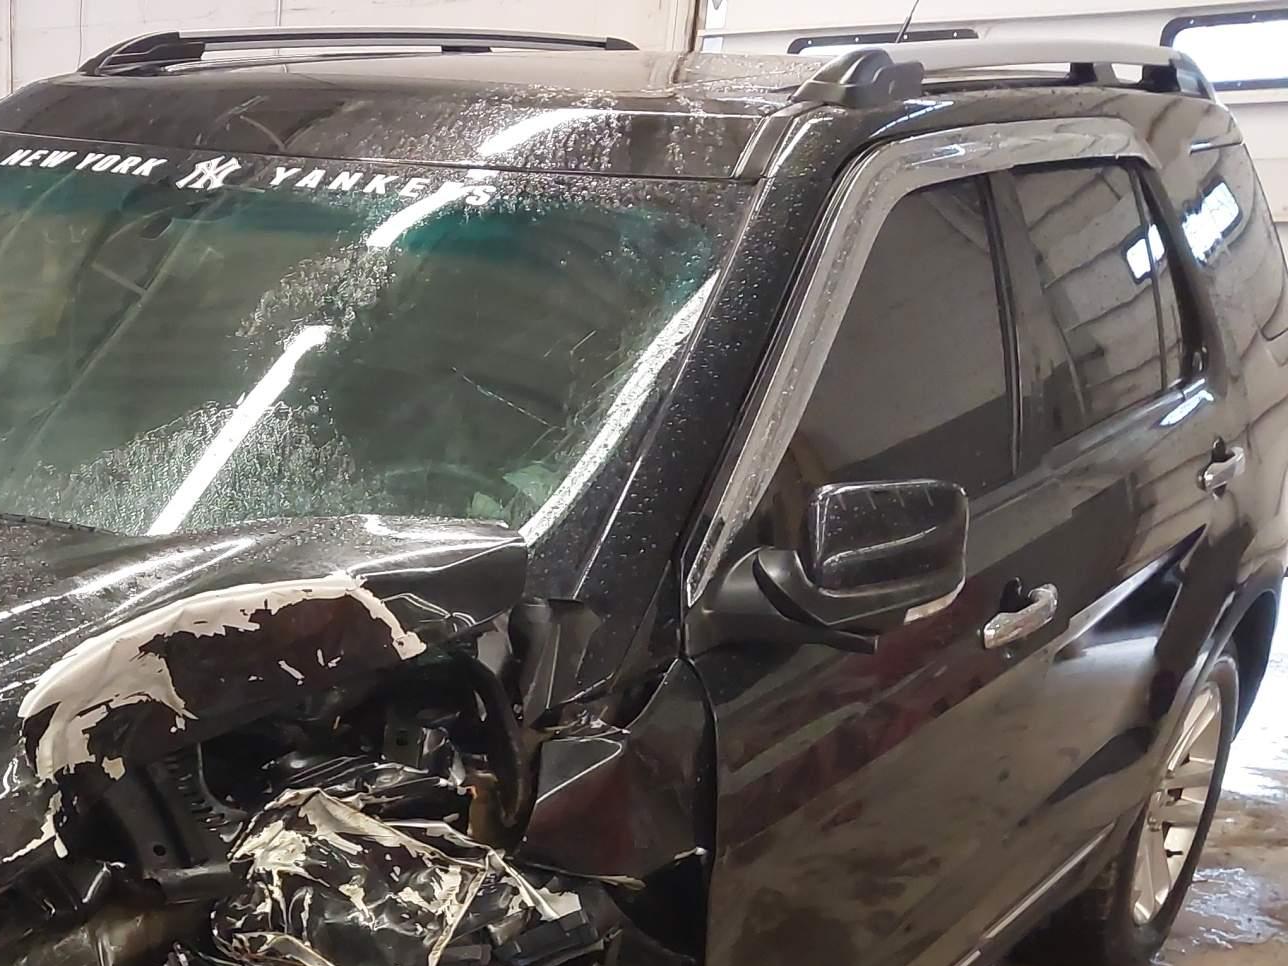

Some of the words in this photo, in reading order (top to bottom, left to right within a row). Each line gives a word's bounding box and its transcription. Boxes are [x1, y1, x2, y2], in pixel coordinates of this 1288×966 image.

[0, 148, 78, 169] NEW
[74, 151, 169, 177] YORK
[269, 166, 497, 206] YANKES
